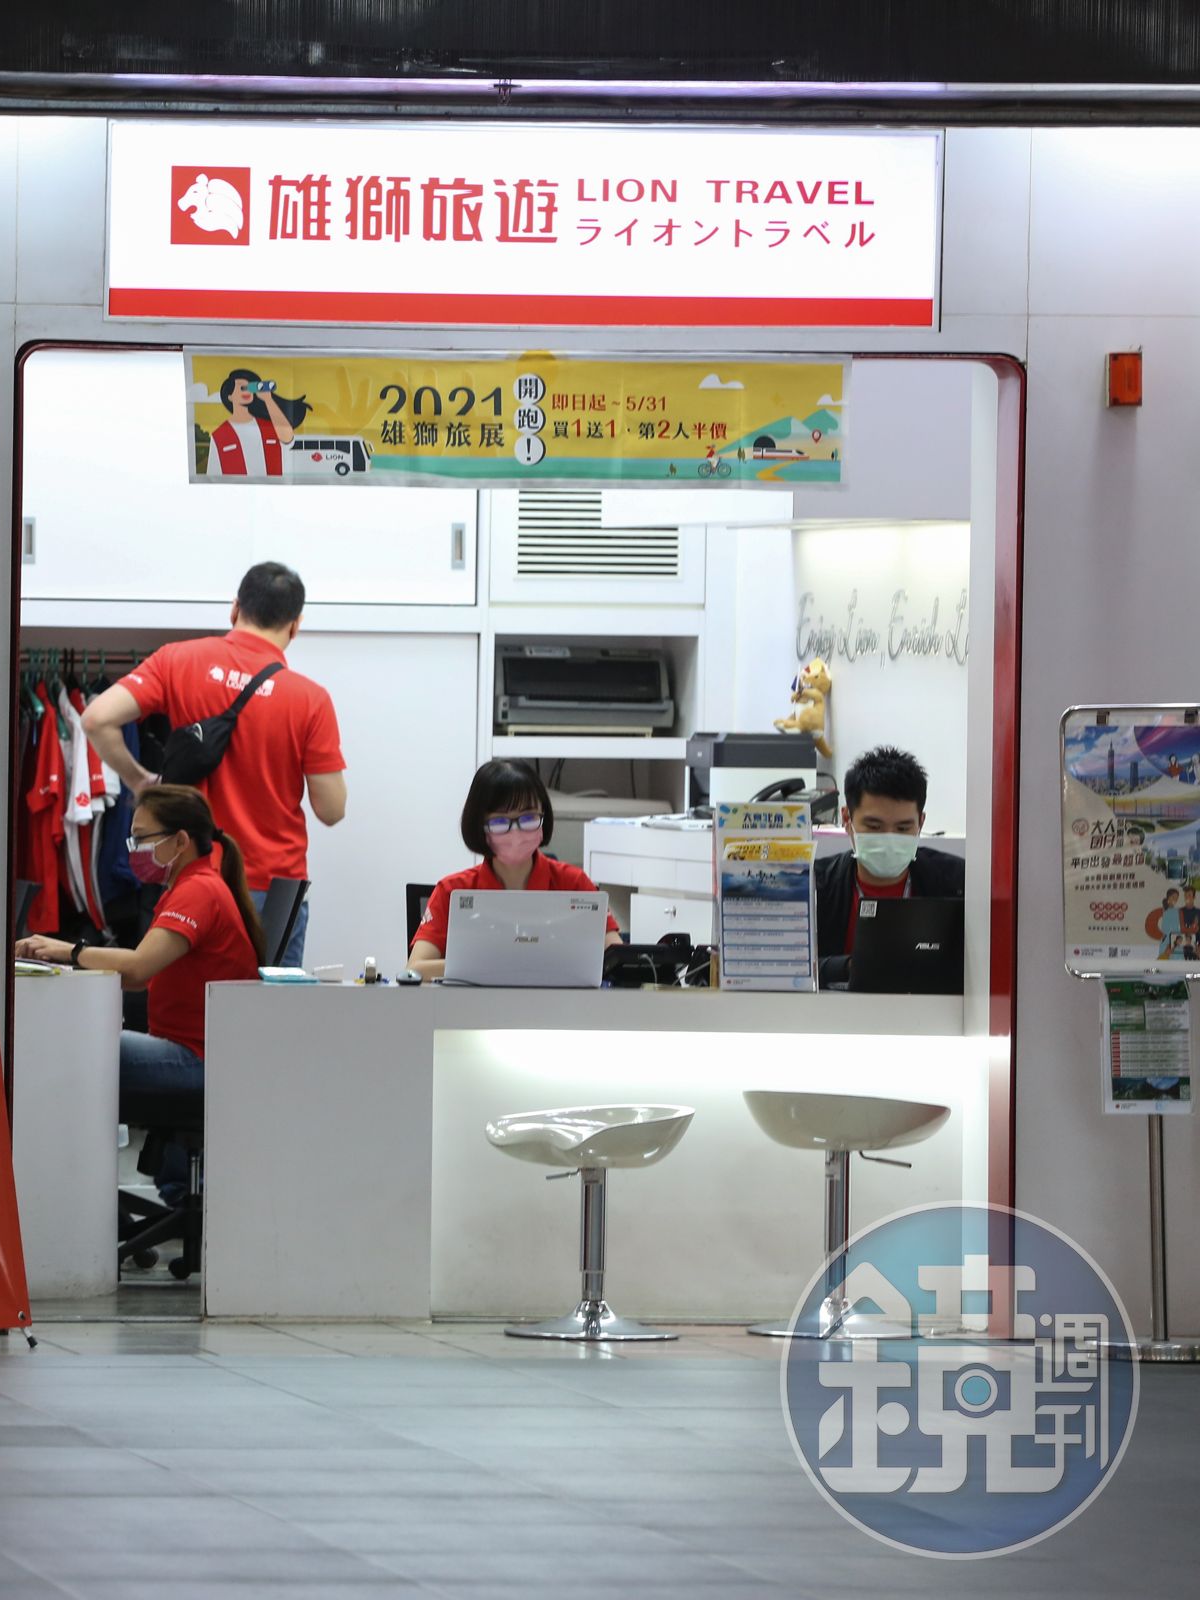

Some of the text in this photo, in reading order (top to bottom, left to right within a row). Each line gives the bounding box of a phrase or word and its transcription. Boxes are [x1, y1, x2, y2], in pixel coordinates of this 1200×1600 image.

[577, 178, 875, 205] LION TRAVEL
[268, 174, 559, 243] 雄獅旅遊
[576, 218, 876, 248] ライオントラベル
[379, 384, 502, 417] 2021
[380, 420, 505, 448] 雄獅旅展
[325, 453, 344, 461] LION
[915, 942, 940, 950] ASUS
